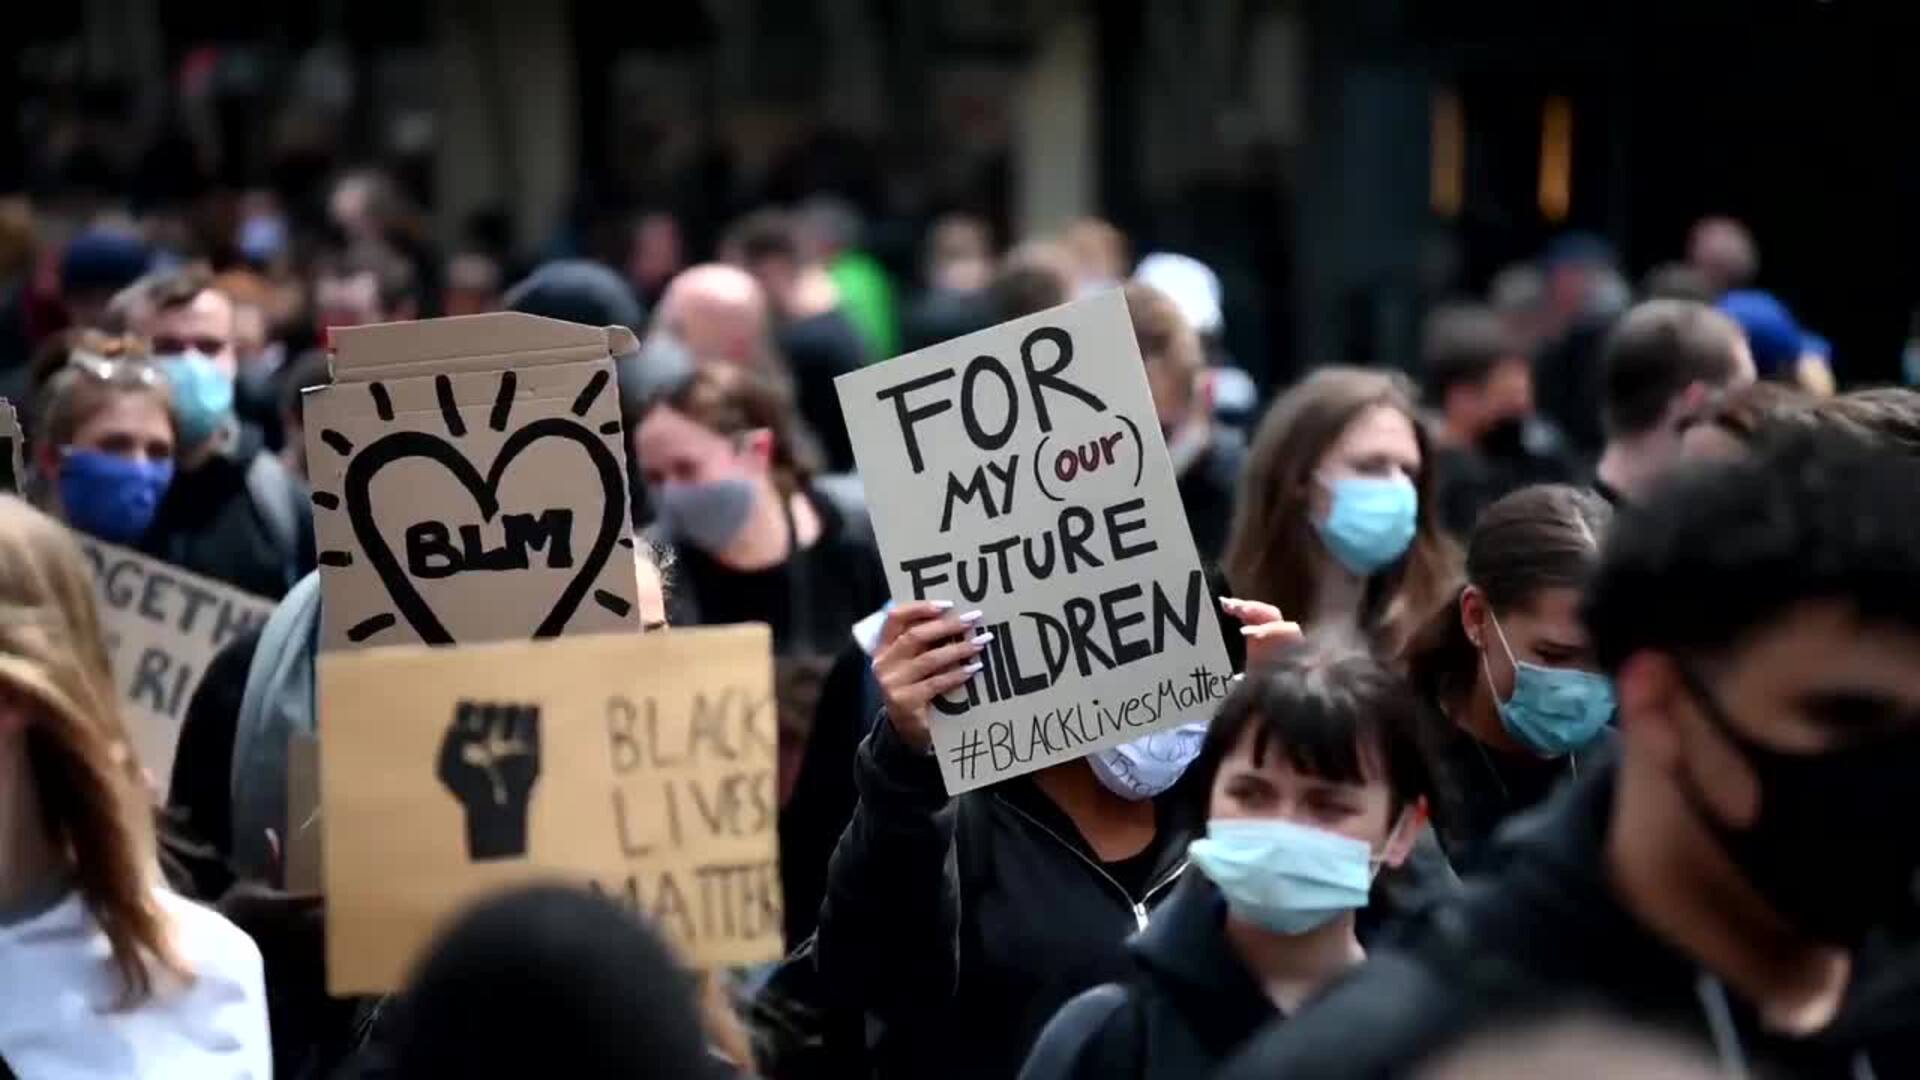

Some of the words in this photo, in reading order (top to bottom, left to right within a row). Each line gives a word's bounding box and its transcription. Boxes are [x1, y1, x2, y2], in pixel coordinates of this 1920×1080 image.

[876, 326, 1107, 473] FOR
[939, 454, 1019, 533] MY
[1033, 415, 1144, 501] (our)
[405, 508, 573, 579] BLM
[900, 498, 1158, 603] FUTURE
[606, 685, 776, 775] BLACK
[610, 771, 772, 858] LIVES
[588, 862, 779, 944] ATTER
